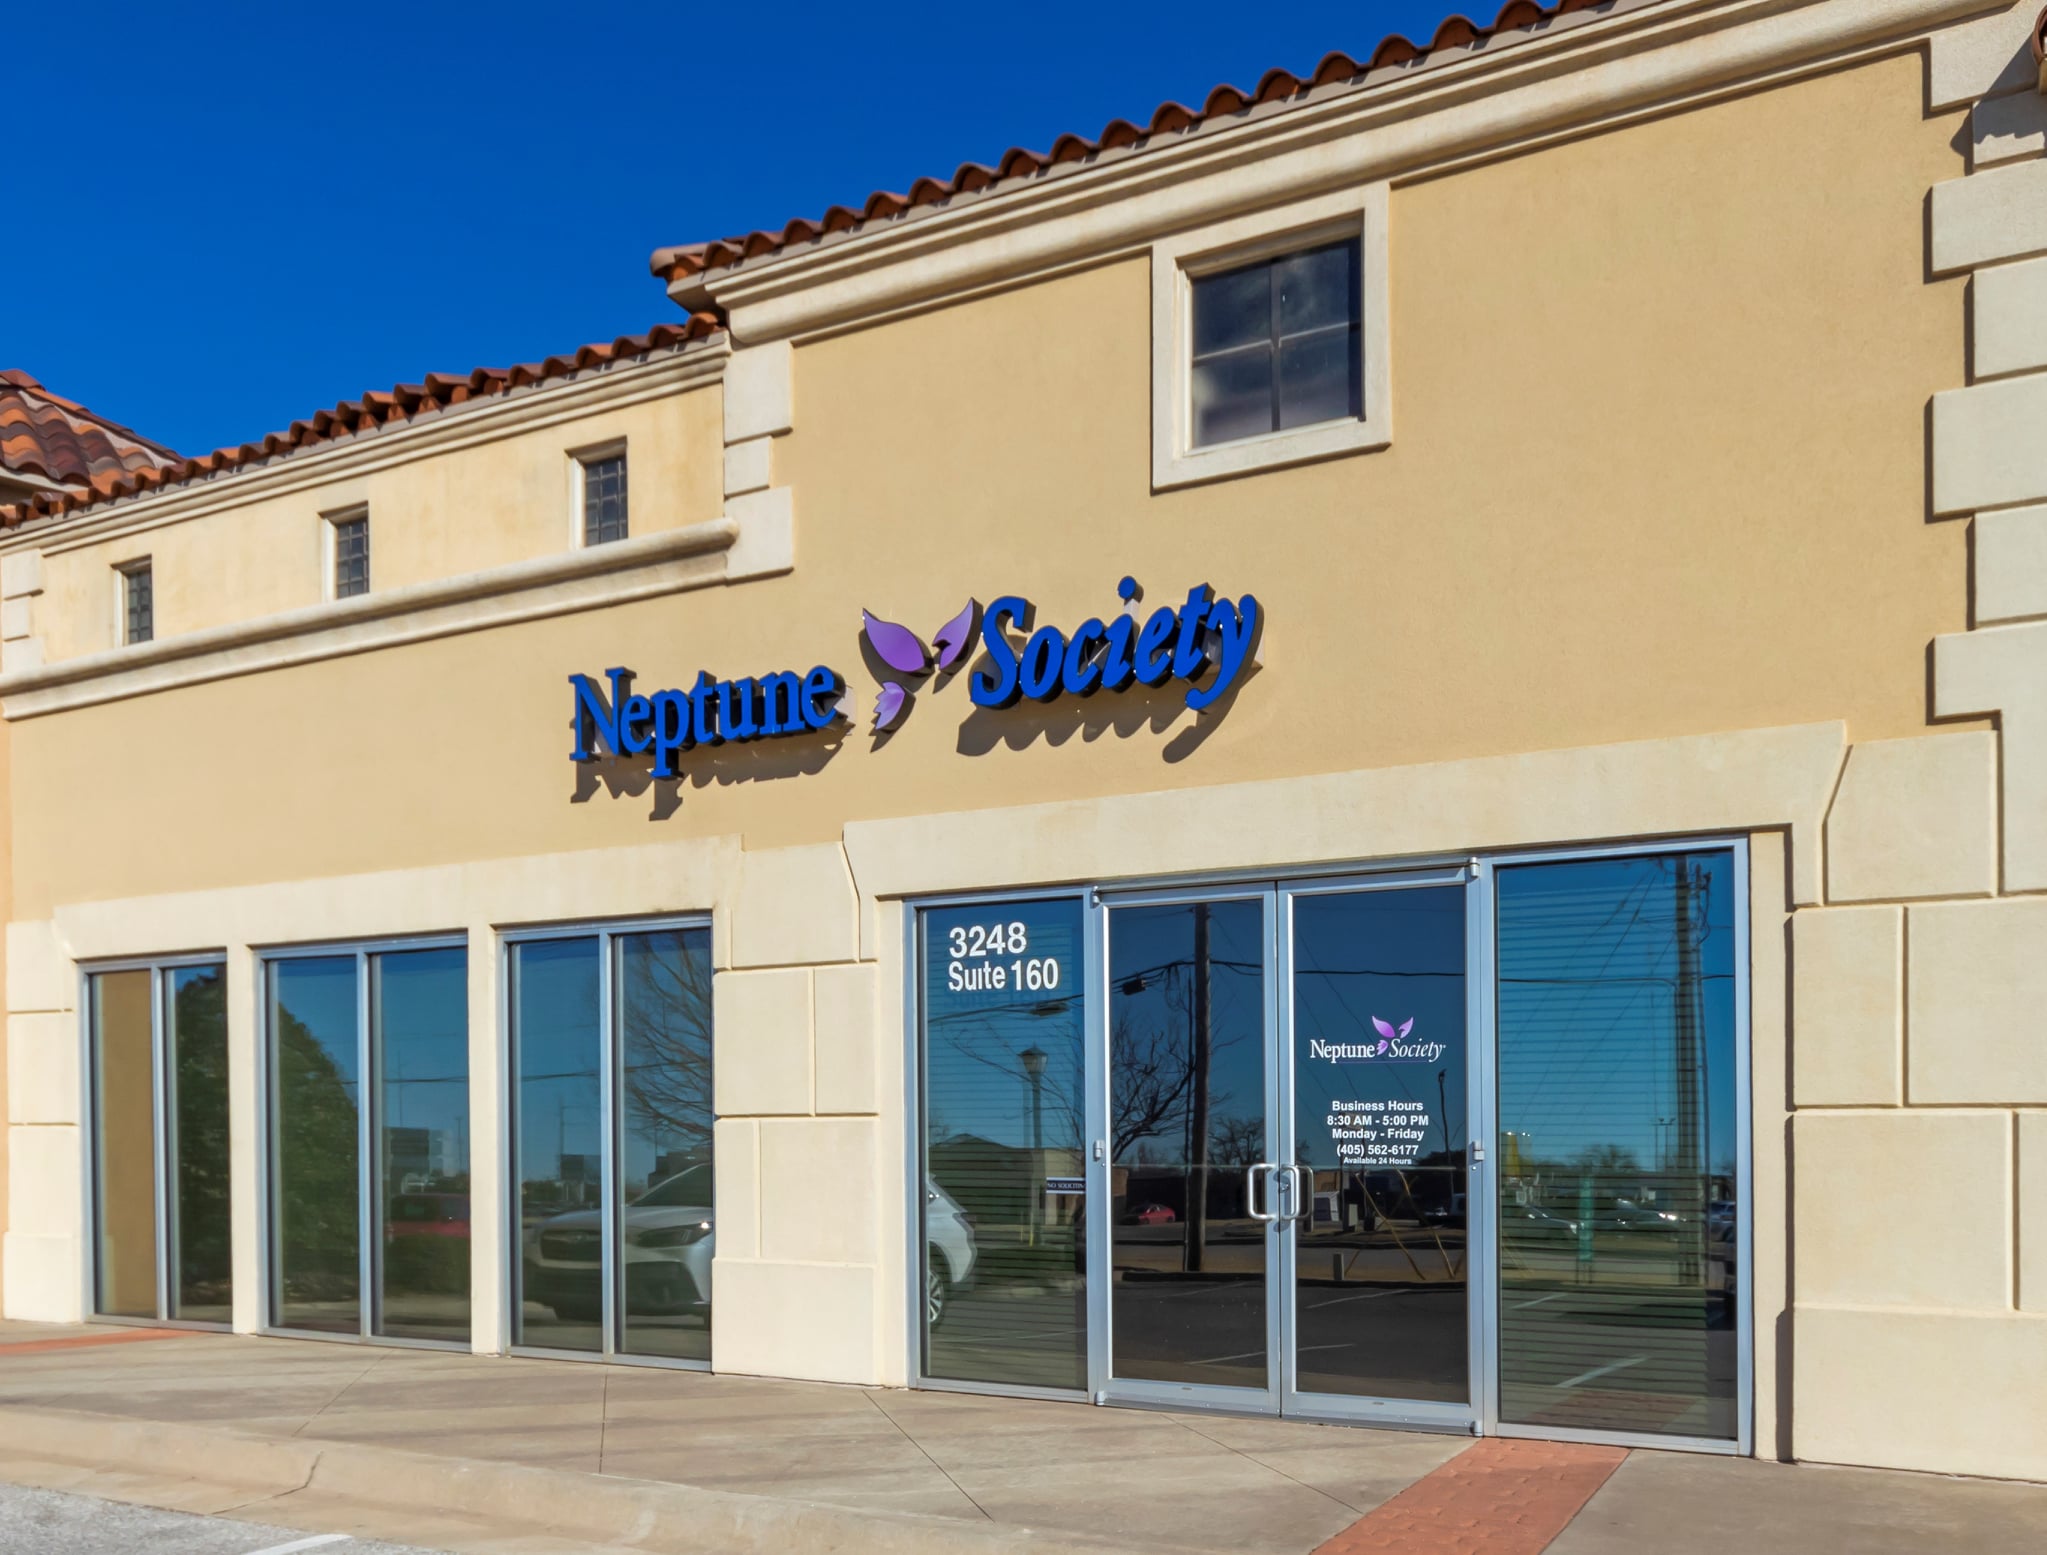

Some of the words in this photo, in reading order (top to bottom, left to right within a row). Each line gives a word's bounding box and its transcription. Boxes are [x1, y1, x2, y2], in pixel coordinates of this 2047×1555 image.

[569, 664, 848, 777] Neptune
[971, 576, 1262, 710] Society
[949, 921, 1027, 958] 3248
[948, 960, 1006, 992] Suite
[1010, 958, 1059, 991] 160
[1310, 1039, 1376, 1064] Neptune
[1388, 1038, 1443, 1063] Society
[1332, 1100, 1385, 1112] Business
[1387, 1100, 1424, 1112] Hours
[1326, 1114, 1351, 1126] 8:30
[1353, 1114, 1373, 1126] AM
[1382, 1114, 1407, 1126] 5:00
[1410, 1114, 1429, 1126] PM
[1332, 1128, 1377, 1141] Monday
[1387, 1128, 1424, 1142] Friday
[1336, 1144, 1365, 1157] (405)
[1367, 1144, 1419, 1155] 562-6177
[1343, 1156, 1377, 1165] Available
[1378, 1157, 1388, 1165] 24
[1389, 1157, 1413, 1165] Hours
